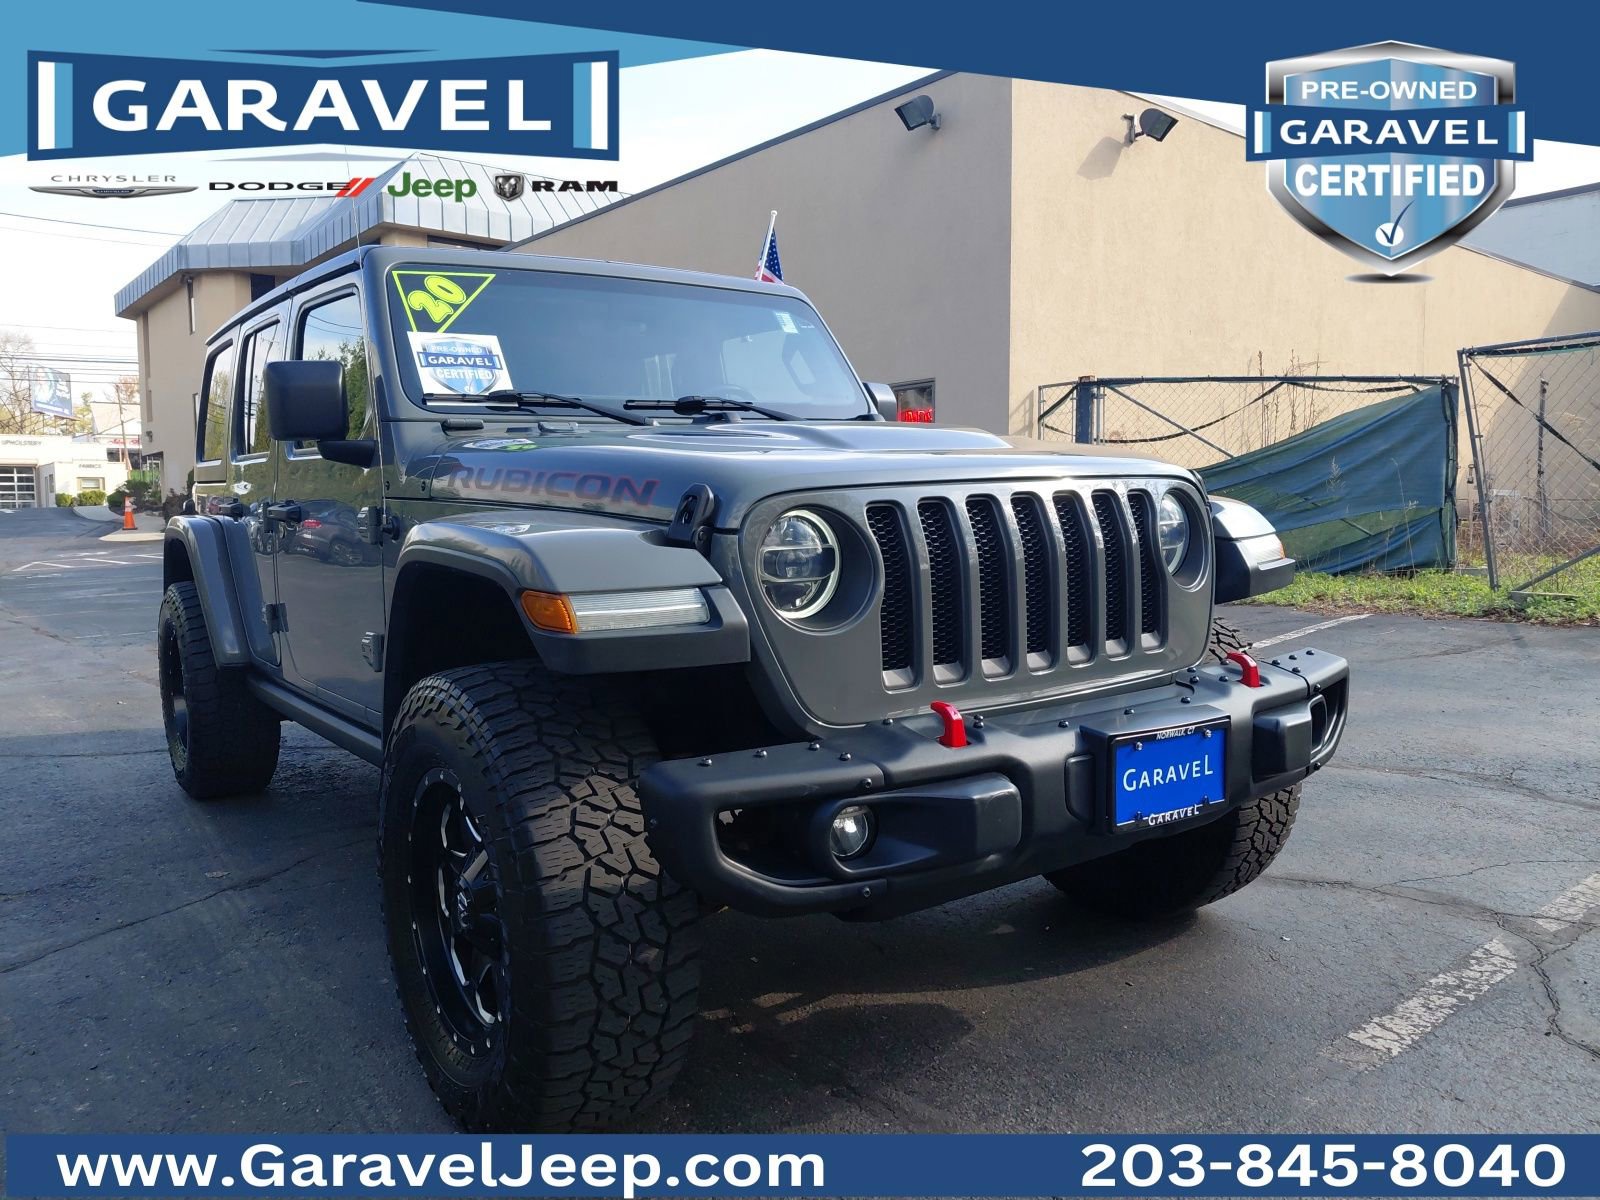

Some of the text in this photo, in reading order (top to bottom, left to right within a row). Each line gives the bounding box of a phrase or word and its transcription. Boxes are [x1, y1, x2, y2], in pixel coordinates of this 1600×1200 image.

[407, 275, 467, 323] 20
[427, 355, 493, 366] GARAVEL
[436, 368, 493, 380] CERTIFIED
[447, 465, 660, 506] RUBICON
[1123, 754, 1213, 792] GARAVEL
[1148, 804, 1199, 826] GARAVEL
